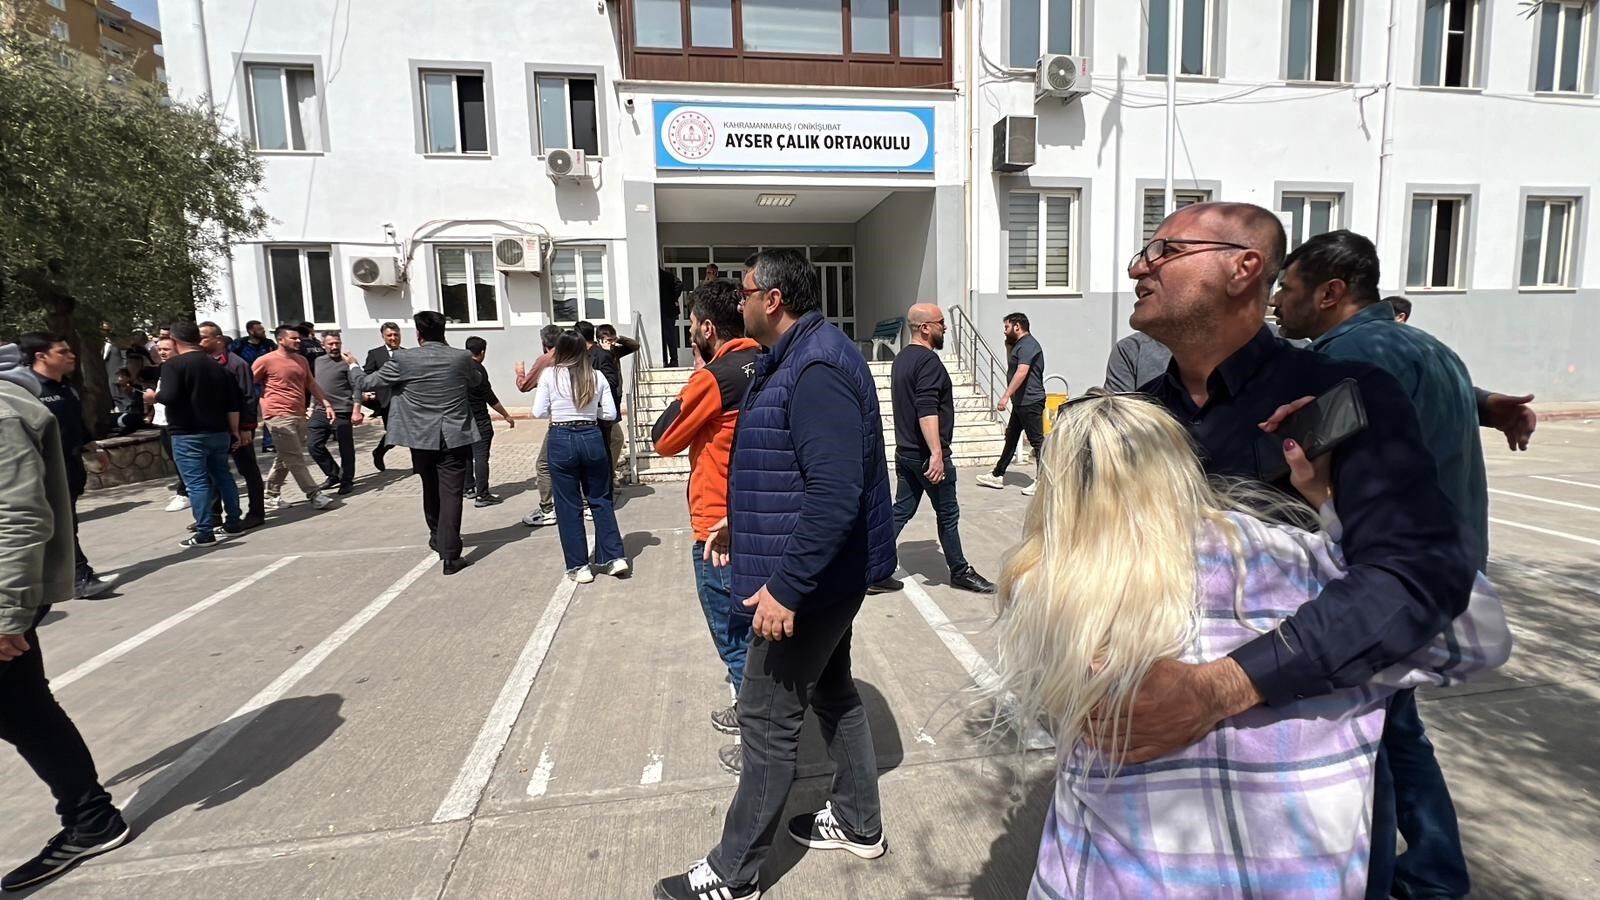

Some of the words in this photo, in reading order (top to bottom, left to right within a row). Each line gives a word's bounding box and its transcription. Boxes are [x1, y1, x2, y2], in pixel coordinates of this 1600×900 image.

[723, 121, 792, 131] KAHRAMANMARAŞ
[725, 133, 773, 148] AYSER
[776, 134, 820, 151] ÇALIK
[823, 135, 910, 150] ORTAOKULU
